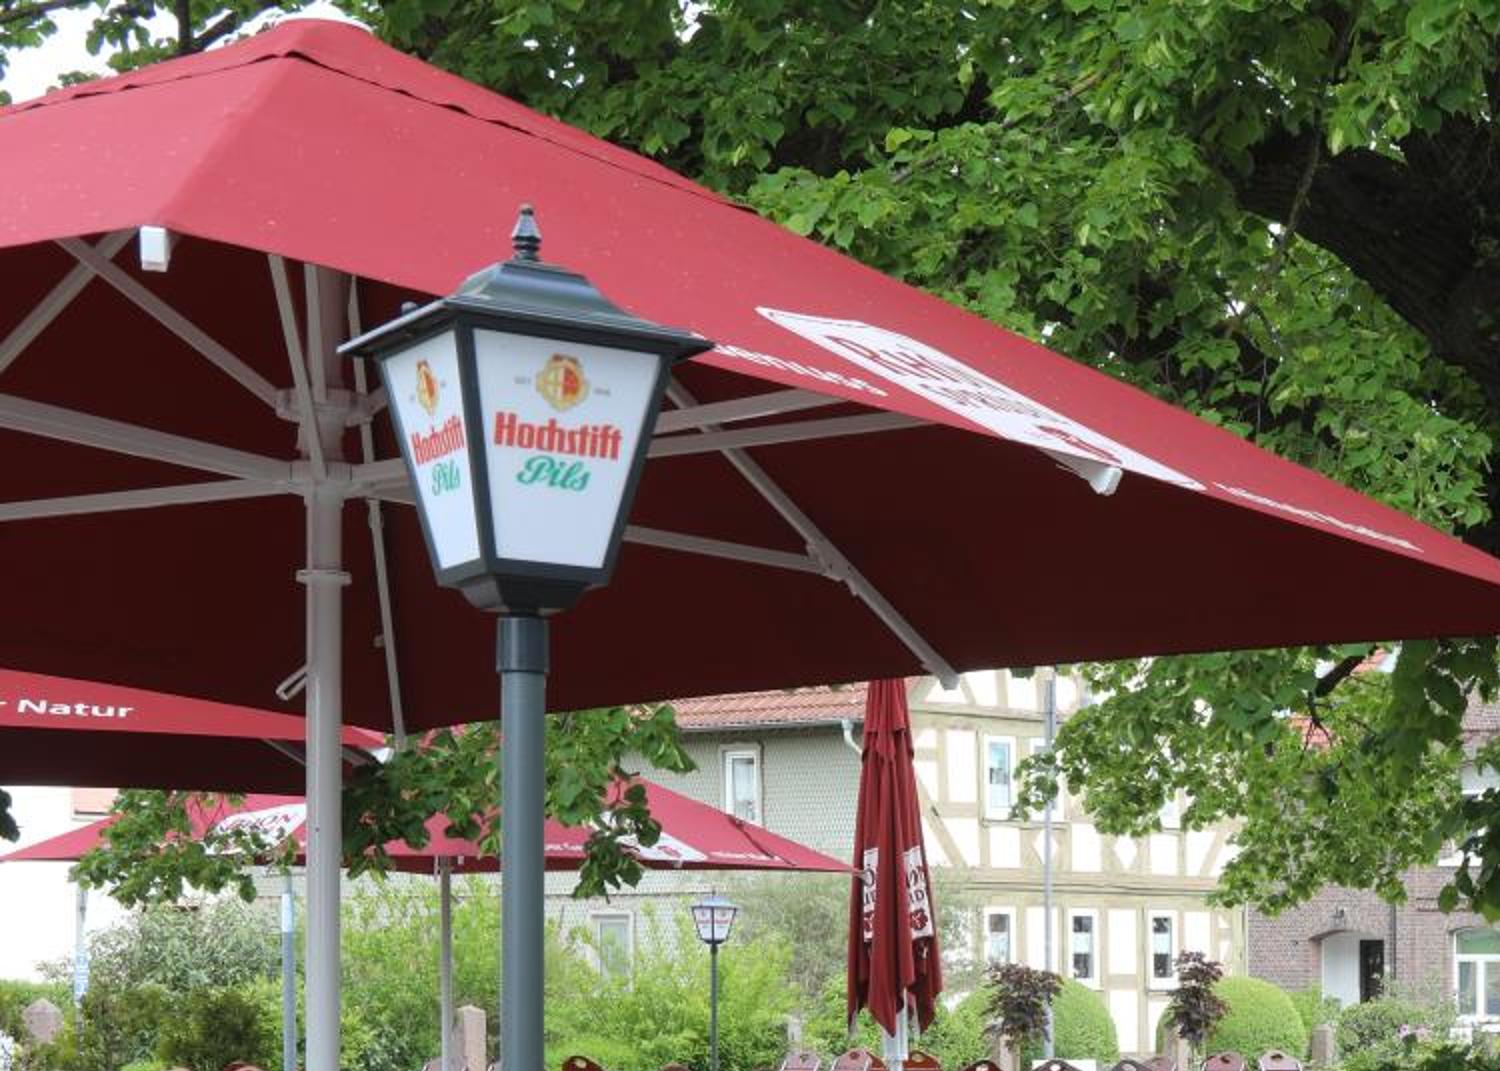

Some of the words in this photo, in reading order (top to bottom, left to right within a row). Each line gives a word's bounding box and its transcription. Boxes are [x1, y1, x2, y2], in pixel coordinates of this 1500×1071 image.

[411, 414, 465, 466] Hochstift
[494, 411, 623, 461] Hochstift
[431, 461, 460, 496] Pils
[516, 455, 591, 492] Pils
[17, 699, 134, 718] Natur
